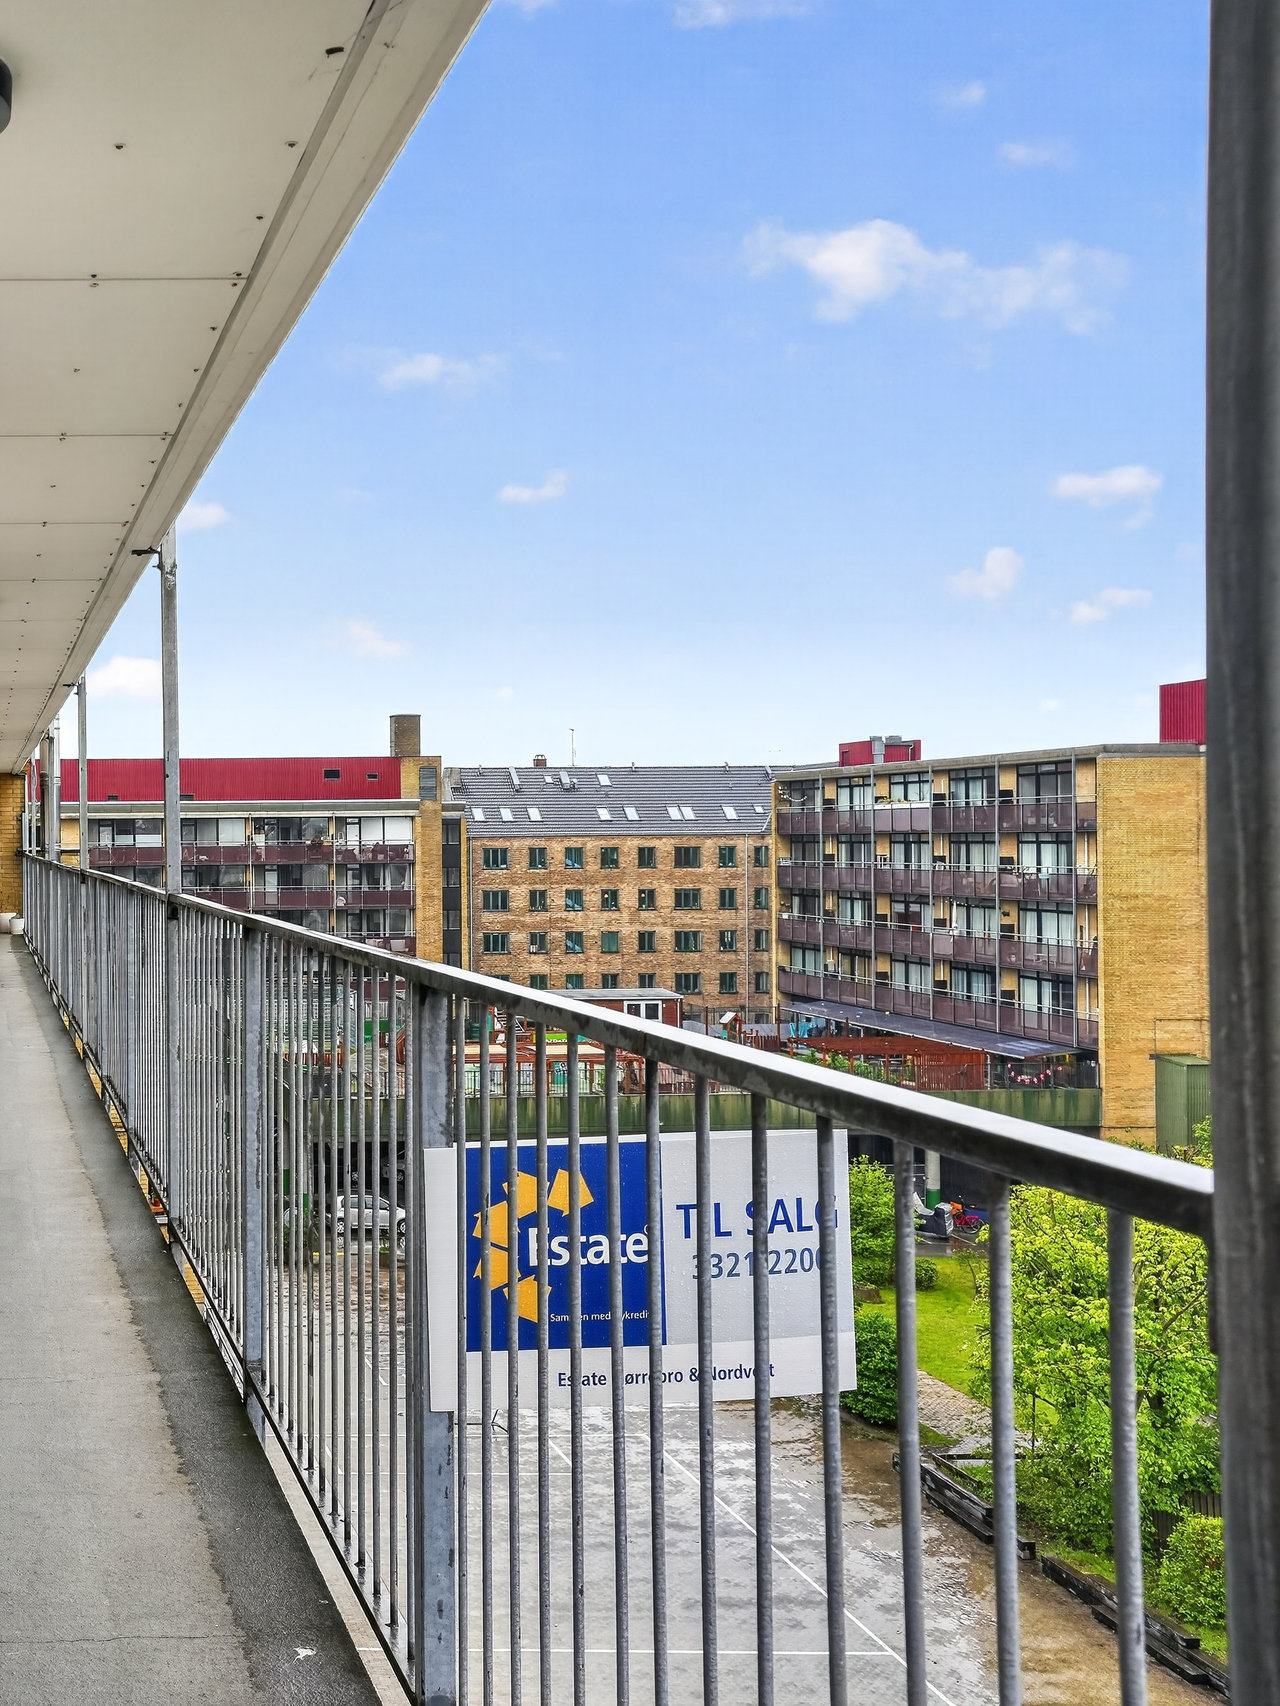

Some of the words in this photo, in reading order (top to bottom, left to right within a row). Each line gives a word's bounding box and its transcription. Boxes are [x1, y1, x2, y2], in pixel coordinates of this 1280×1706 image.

[675, 1202, 732, 1239] TL
[550, 1312, 589, 1322] Samen
[591, 1311, 611, 1321] med
[619, 1309, 649, 1321] ykredi
[557, 1371, 607, 1387] Esate
[622, 1370, 684, 1386] ørrro
[688, 1367, 700, 1382] &
[711, 1363, 775, 1382] ordvt
